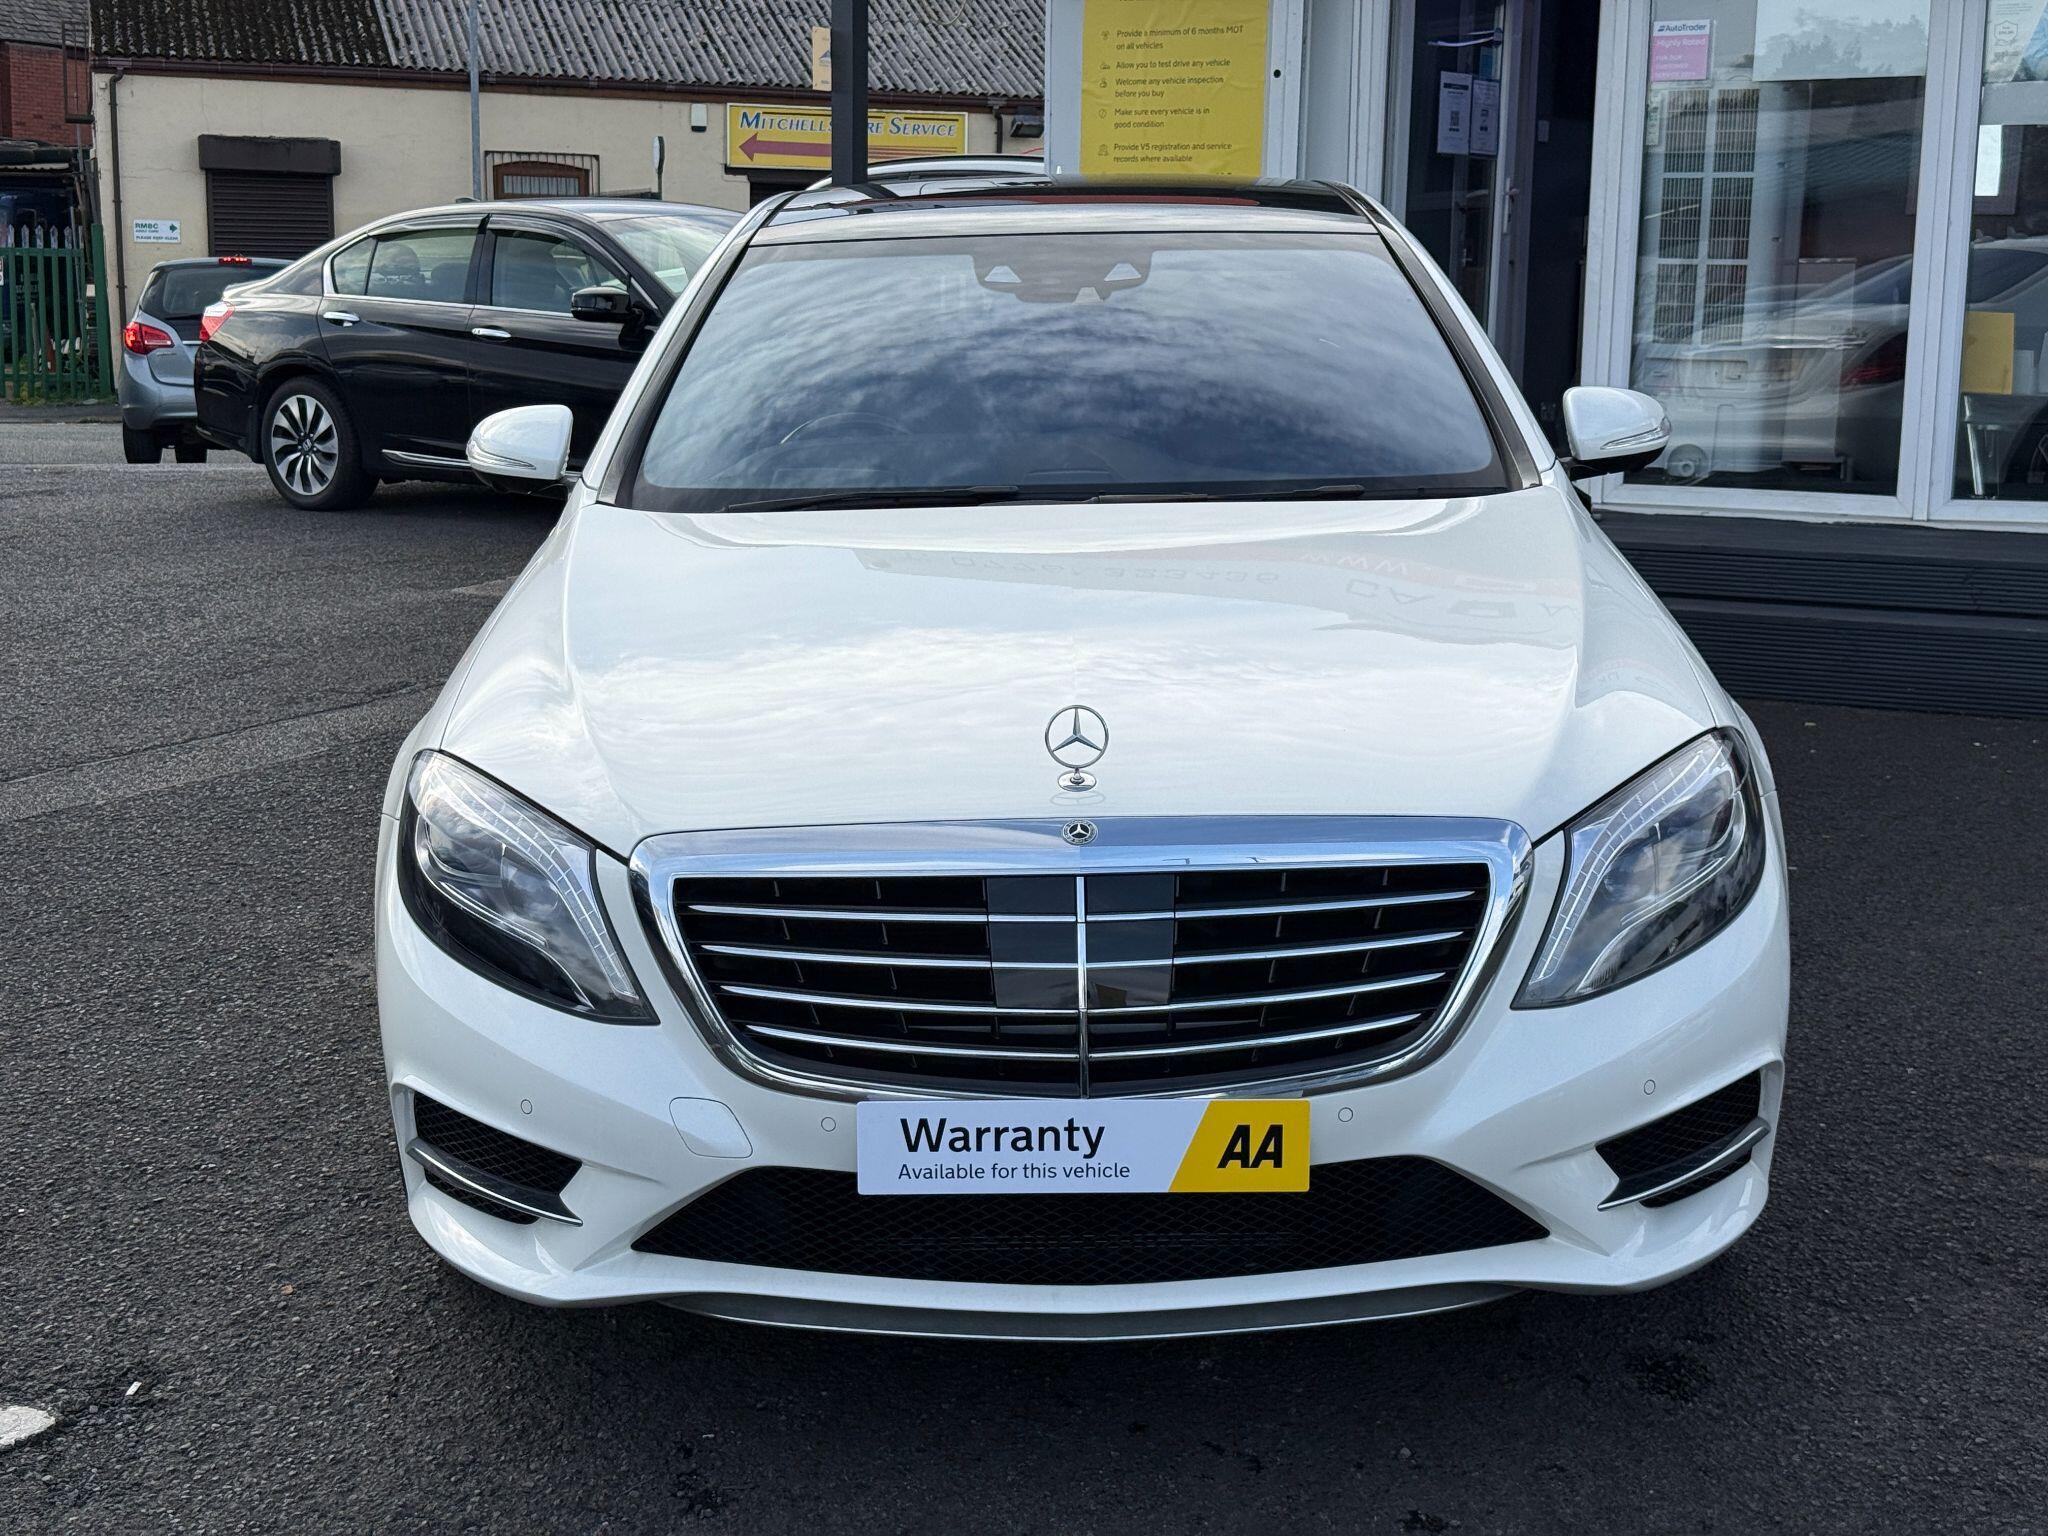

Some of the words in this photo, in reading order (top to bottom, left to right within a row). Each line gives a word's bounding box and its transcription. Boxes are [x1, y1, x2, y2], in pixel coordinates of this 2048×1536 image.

[1116, 30, 1143, 38] Provide
[1150, 28, 1182, 37] minimum
[1183, 27, 1190, 36] of
[1191, 27, 1197, 35] 6
[1198, 27, 1225, 35] months
[1226, 25, 1244, 34] MOT
[1135, 41, 1164, 49] vehicles
[1116, 61, 1135, 69] Allow
[1136, 62, 1149, 70] you
[1158, 60, 1172, 68] test
[1172, 59, 1191, 68] drive
[1205, 58, 1231, 67] vehicle
[1116, 78, 1147, 86] Welcome
[1161, 77, 1186, 85] vehicle
[1187, 76, 1224, 85] inspection
[1115, 90, 1137, 98] before
[1152, 90, 1165, 98] buy
[1114, 108, 1133, 116] Make
[1150, 109, 1168, 117] every
[1170, 107, 1195, 115] vehicle
[1196, 107, 1202, 115] is
[740, 111, 832, 132] MITCHELL
[1114, 121, 1132, 129] good
[1133, 120, 1165, 128] condition
[1114, 143, 1140, 151] Provide
[1151, 143, 1191, 152] registration
[1114, 155, 1139, 163] records
[1140, 154, 1161, 162] where
[1162, 154, 1193, 162] available
[899, 1117, 1106, 1159] Warranty
[1216, 1124, 1284, 1169] AA
[898, 1163, 986, 1180] Available
[991, 1163, 1018, 1179] for
[1023, 1164, 1058, 1179] this
[1062, 1162, 1131, 1179] vehicle
